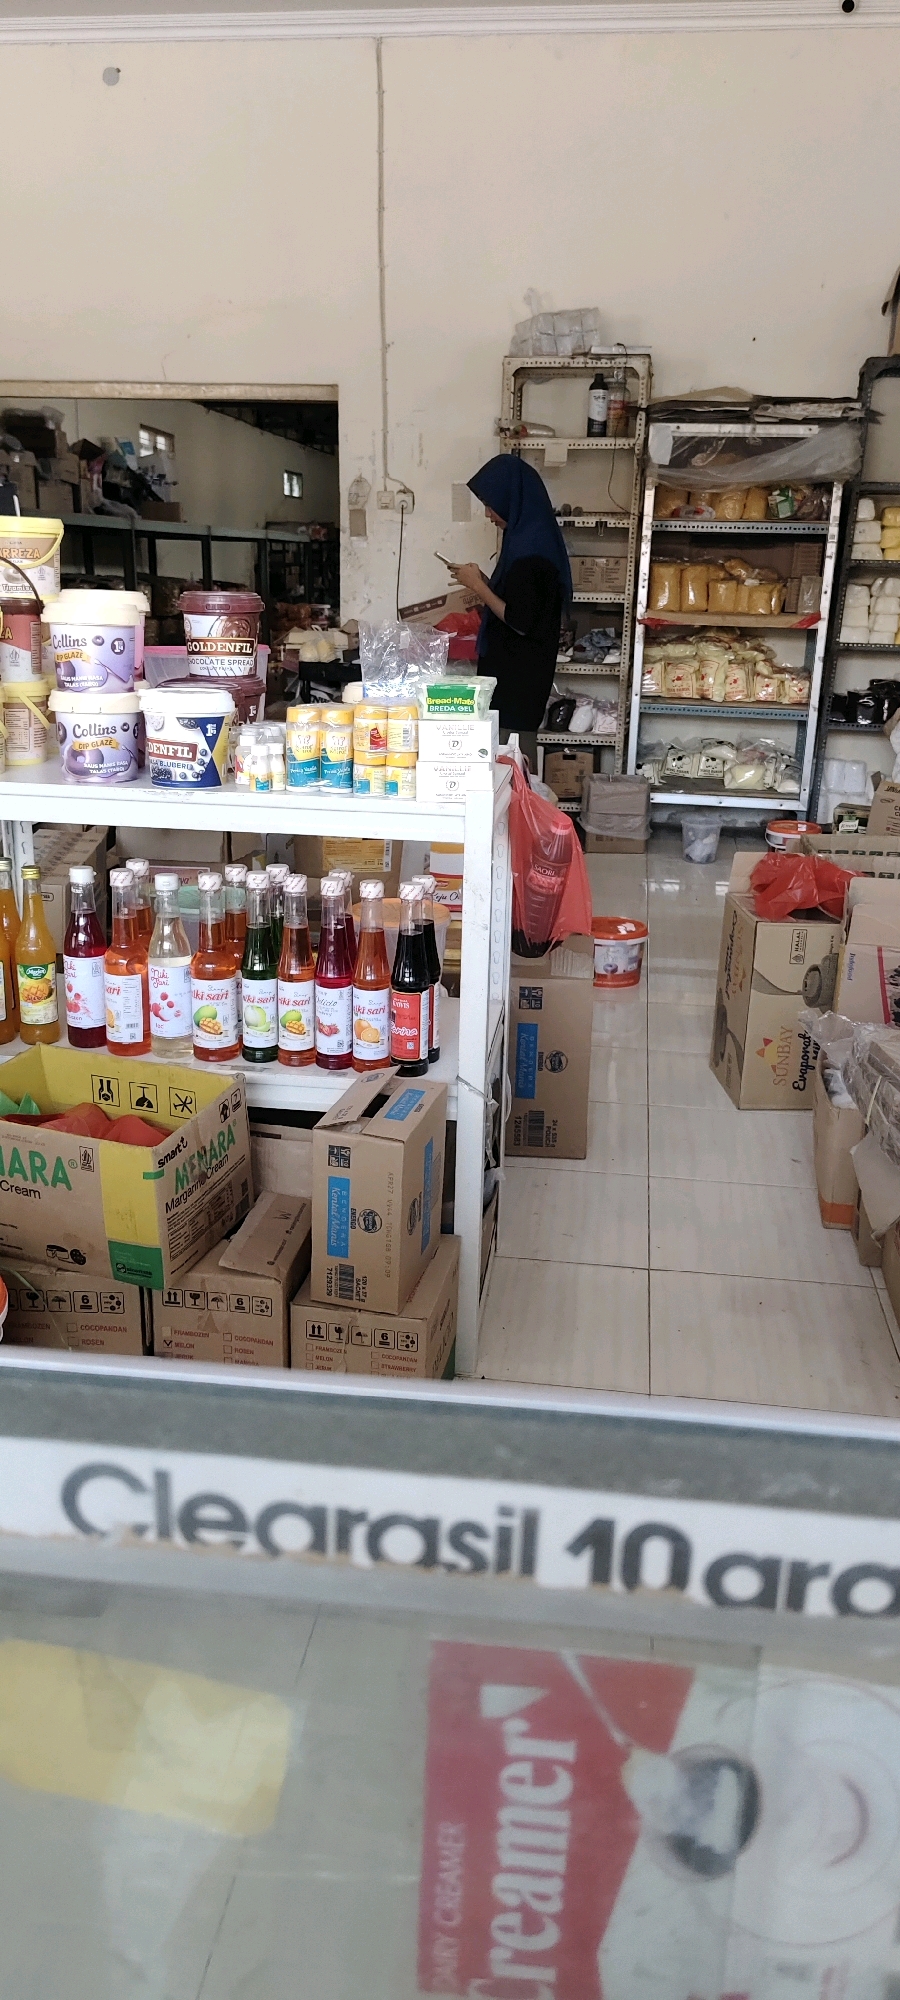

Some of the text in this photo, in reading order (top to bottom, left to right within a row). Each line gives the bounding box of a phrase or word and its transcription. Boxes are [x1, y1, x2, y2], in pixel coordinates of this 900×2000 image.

[187, 642, 252, 654] GOLDENFIL
[72, 722, 117, 738] Collins
[91, 739, 113, 748] GLAZE
[434, 892, 448, 902] eju
[151, 968, 170, 979] Niki
[205, 990, 228, 1000] sari
[256, 993, 276, 1004] sari
[291, 996, 310, 1006] sari
[366, 1006, 386, 1015] sari
[773, 1026, 793, 1086] SUNBAY
[206, 1153, 228, 1180] Cream
[0, 1179, 42, 1200] Cream
[330, 1187, 340, 1247] Kental Manis
[80, 1325, 128, 1333] COCOPANDAN
[174, 1330, 274, 1346] FRAMBOZEN COCOPANDAN
[174, 1341, 254, 1355] MELON ROSEN
[381, 1353, 418, 1363] COCOPANDAN
[381, 1363, 416, 1372] STRAWBERRY
[566, 1516, 692, 1593] 10
[433, 1821, 466, 1928] CREAMER
